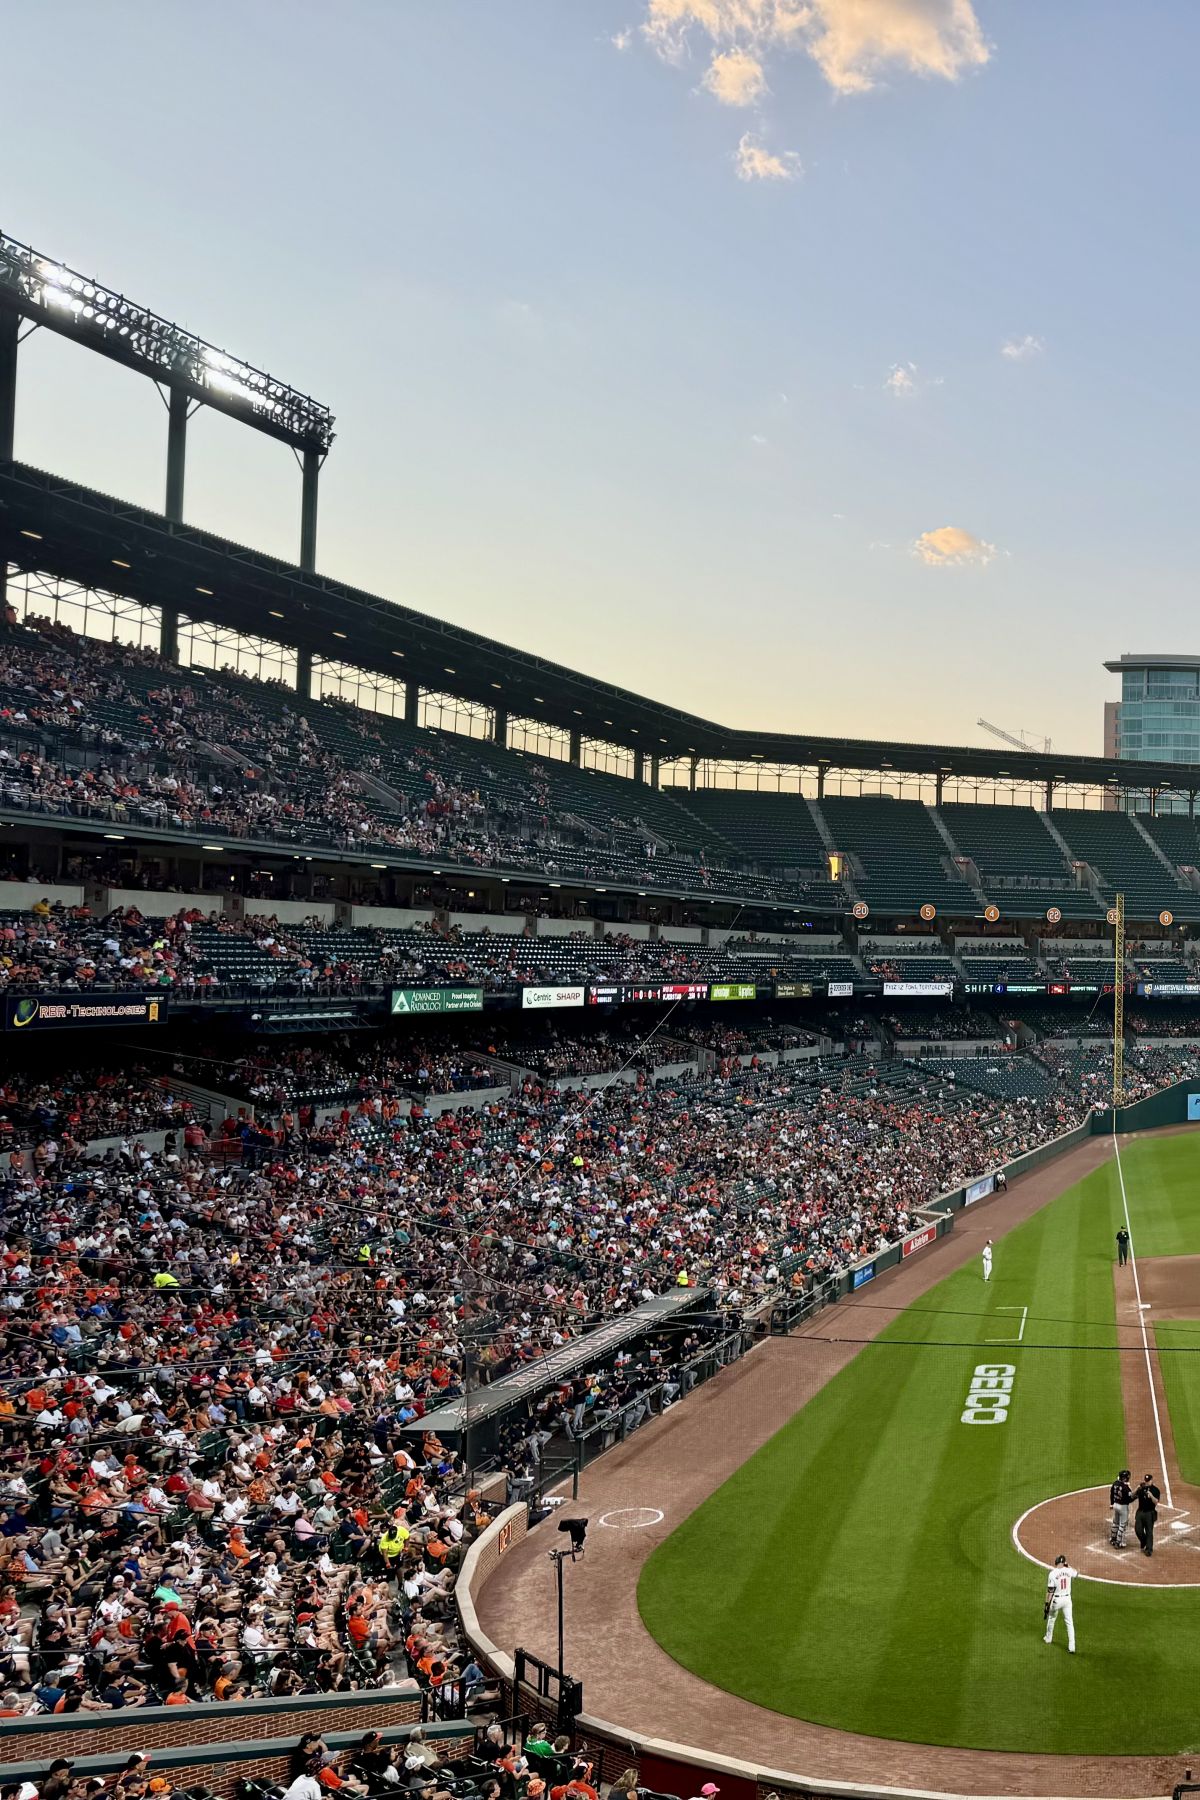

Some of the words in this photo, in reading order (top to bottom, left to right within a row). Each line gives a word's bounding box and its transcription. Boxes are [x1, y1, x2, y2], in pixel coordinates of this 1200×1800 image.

[855, 907, 867, 915] 20
[925, 908, 931, 917] 5
[989, 910, 994, 918] 4
[1049, 910, 1059, 920] 22
[965, 984, 994, 993] SHIFT
[412, 991, 441, 1001] ADVANCED
[462, 992, 477, 1000] Imaging
[533, 993, 552, 1001] Centric
[556, 992, 580, 1001] SHARP
[410, 1001, 442, 1011] RADIOLOGY
[445, 1001, 459, 1009] Partner
[960, 1364, 1017, 1425] GEICO
